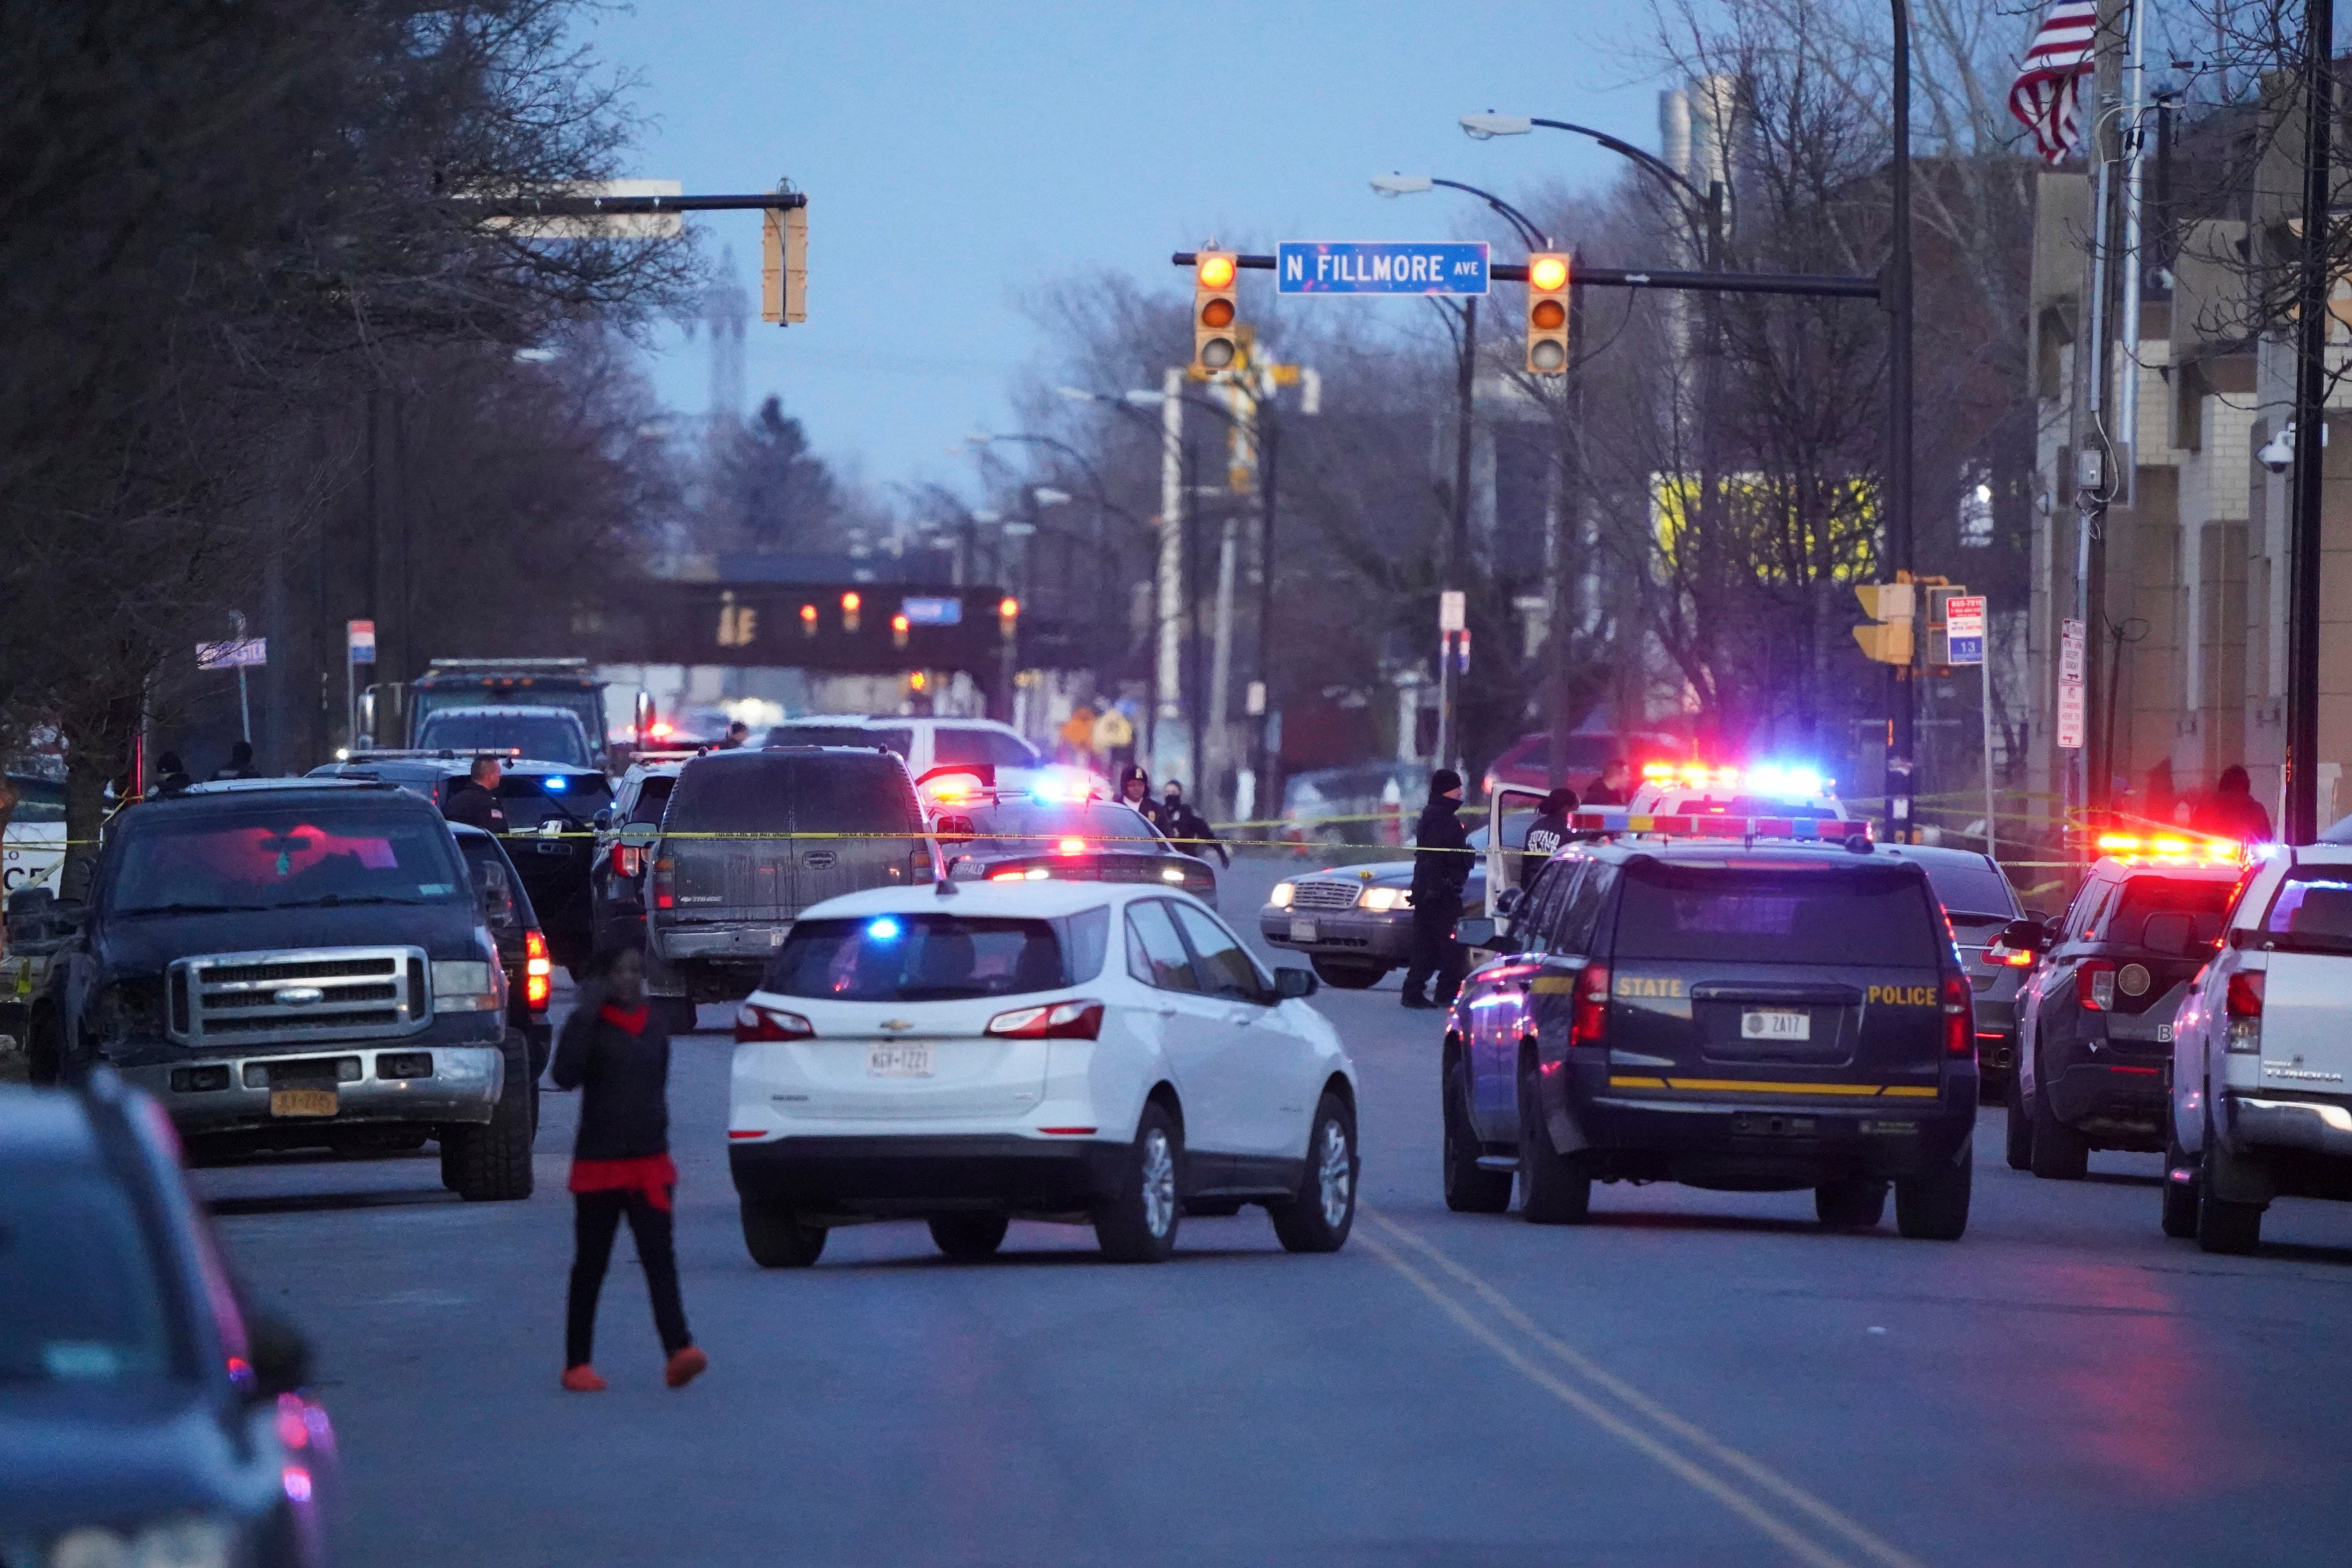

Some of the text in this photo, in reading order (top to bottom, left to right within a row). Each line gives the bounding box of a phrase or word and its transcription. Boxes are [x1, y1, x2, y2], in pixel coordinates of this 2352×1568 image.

[1287, 255, 1479, 281] N FILLMORE AVE
[1960, 641, 1975, 652] 13
[953, 863, 985, 875] BUFFALO
[1618, 978, 1682, 997] STATE
[1867, 986, 1937, 1006] POLICE
